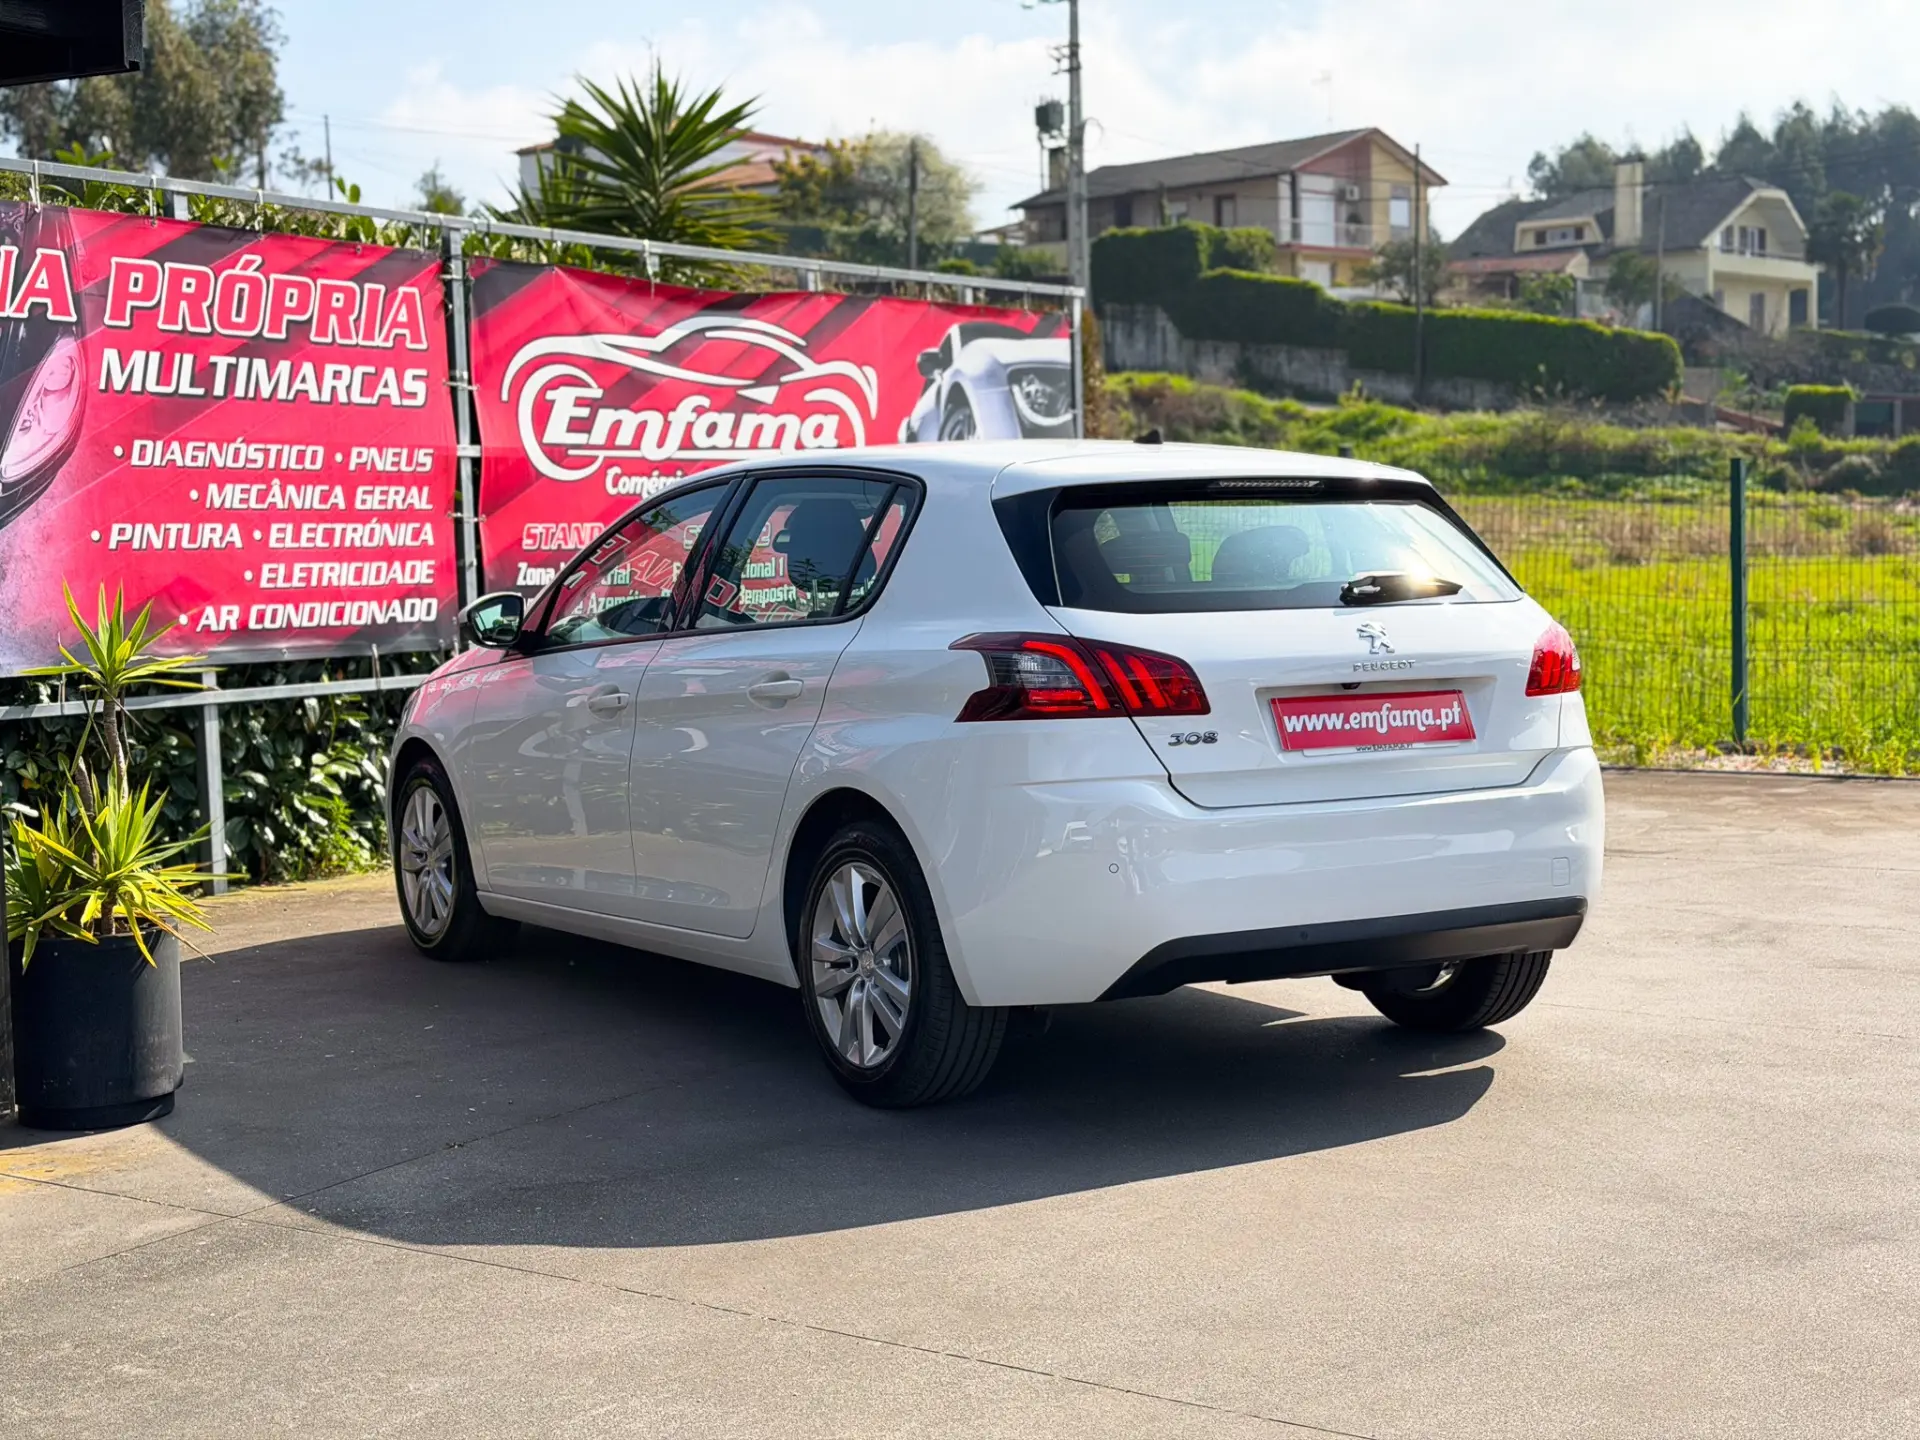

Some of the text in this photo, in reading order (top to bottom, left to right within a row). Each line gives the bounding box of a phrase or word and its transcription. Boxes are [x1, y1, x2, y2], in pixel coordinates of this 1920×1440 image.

[104, 254, 429, 350] PRÓPRIA
[99, 348, 428, 407] MULTIMARCAS
[542, 386, 840, 461] Emfama
[130, 437, 435, 473] DIAGNÓSTICO PNEUS
[205, 479, 434, 511] MECÂNICA GERAL
[108, 518, 435, 550] PINTURA ELECTRÓNICA
[259, 560, 435, 590] ELETRICIDADE
[196, 598, 438, 633] AR CONDICIONADO
[1353, 659, 1416, 672] PEUGEOT
[1284, 701, 1461, 734] www.emfama.pt
[1168, 731, 1218, 746] 308
